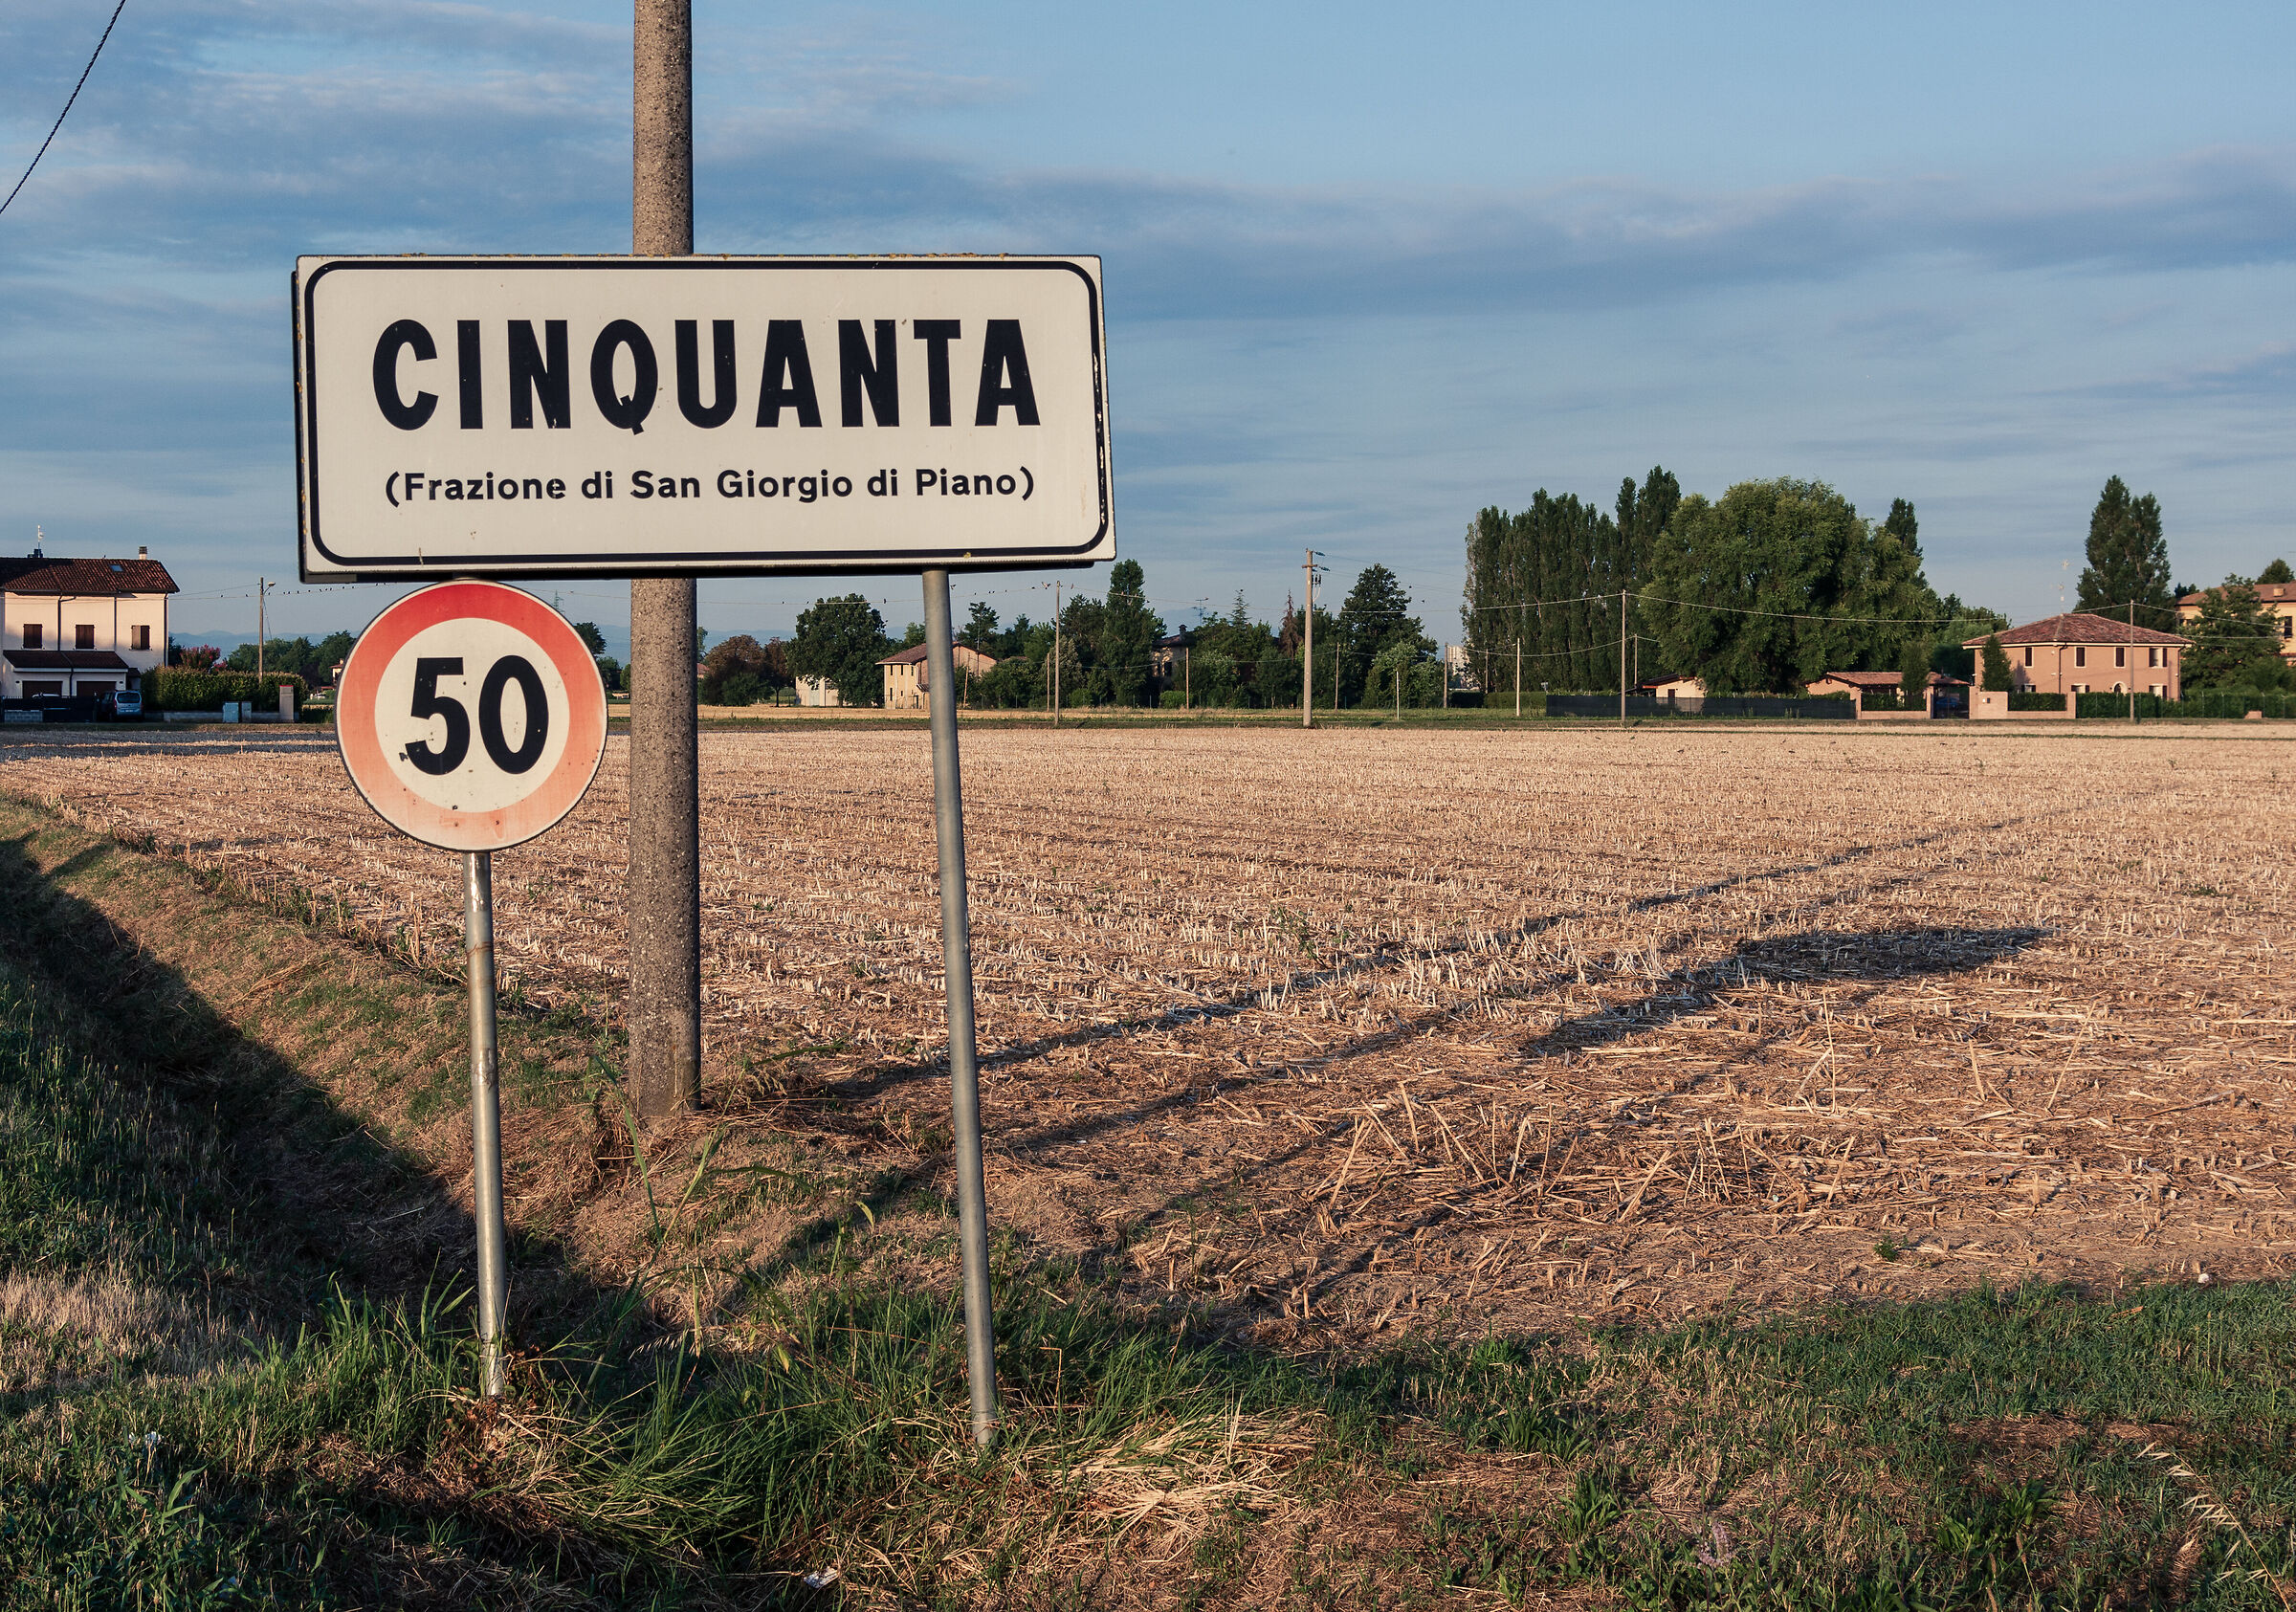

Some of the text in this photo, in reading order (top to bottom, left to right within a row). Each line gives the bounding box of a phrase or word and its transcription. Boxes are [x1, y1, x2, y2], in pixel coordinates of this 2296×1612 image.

[372, 319, 1041, 436] CINQUANTA
[385, 465, 1034, 508] (Frazione di San Giorgio di Piano)
[404, 654, 550, 776] 50
